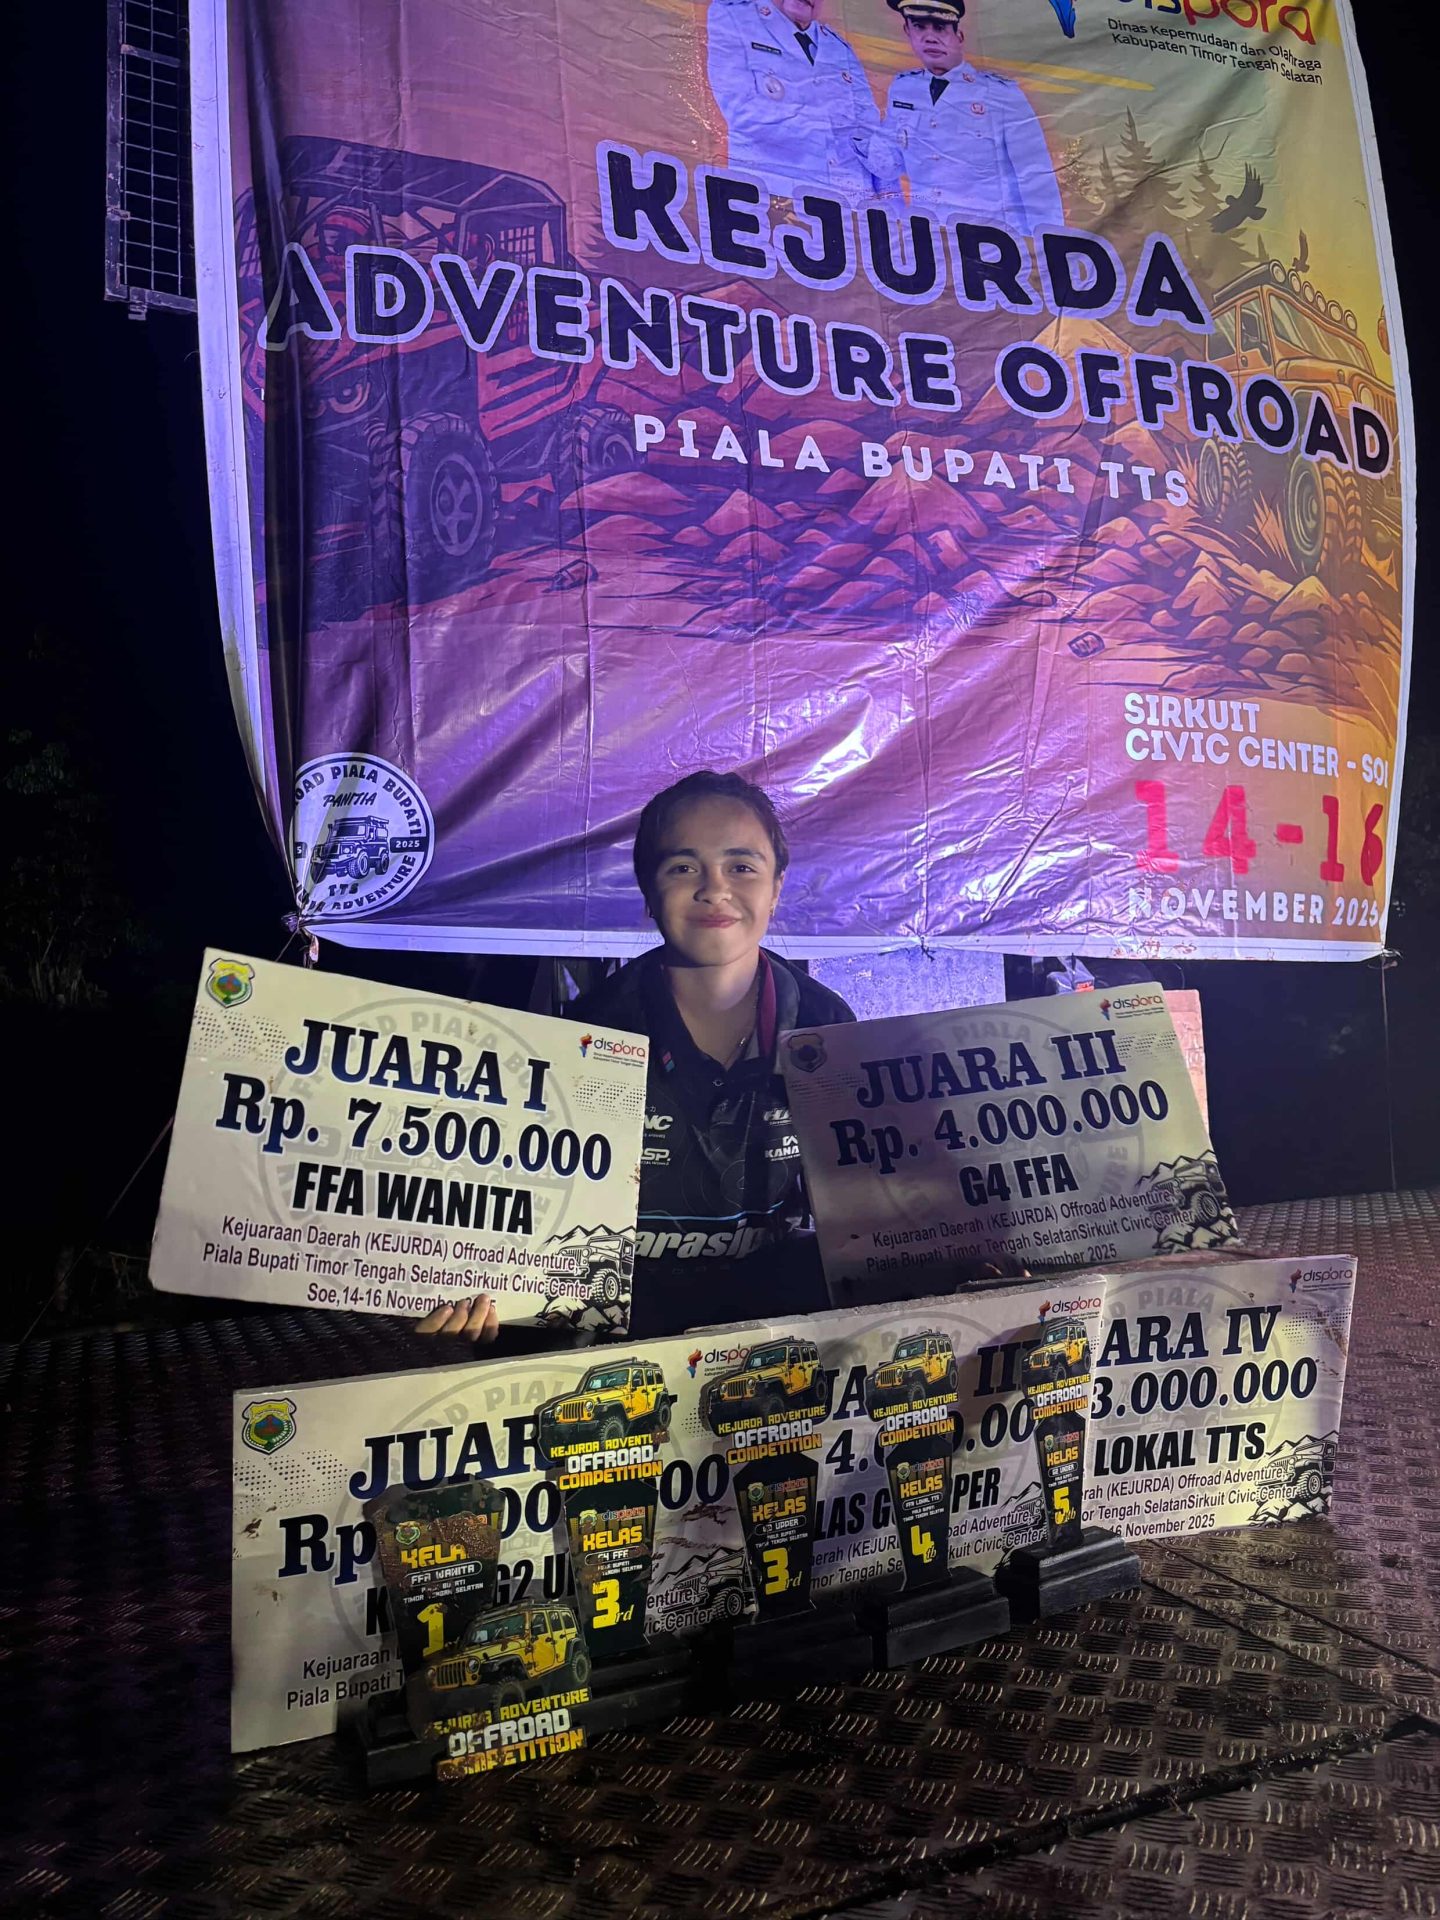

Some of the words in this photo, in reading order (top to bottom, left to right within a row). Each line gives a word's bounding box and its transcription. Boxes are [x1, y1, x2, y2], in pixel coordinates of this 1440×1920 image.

[1108, 18, 1147, 34] Dinas
[1150, 24, 1238, 52] Kepemudaan
[1240, 40, 1265, 57] dan
[1268, 45, 1322, 71] Olahraga
[1111, 33, 1187, 56] Kabupaten
[1189, 45, 1227, 66] Timor
[1230, 55, 1279, 73] Tengah
[1281, 63, 1323, 86] Selatan
[600, 144, 1210, 330] KEJURDA
[260, 244, 960, 410] ADVENTURE
[997, 343, 1391, 477] OFFROAD
[634, 415, 831, 473] PIALA
[862, 441, 1075, 495] BUPATI
[1099, 463, 1190, 507] TTS
[1123, 692, 1260, 733] SIRKUIT
[1125, 728, 1229, 764] CIVIC
[1238, 736, 1339, 778] CENTER
[322, 792, 378, 808] PANITIA
[330, 764, 378, 784] PIALA
[382, 778, 422, 835] BUPATI
[395, 840, 421, 849] 2025
[328, 883, 359, 897] TTS
[331, 855, 416, 911] ADVENTURE
[1128, 888, 1323, 924] NOVEMBER
[1331, 898, 1379, 927] 2025
[1113, 994, 1163, 1010] dispora
[594, 1038, 645, 1057] dispora
[285, 1019, 508, 1105] JUARA
[523, 1058, 551, 1112] I
[857, 1042, 1047, 1108] JUARA
[1051, 1030, 1126, 1081] III
[215, 1073, 319, 1154] Rp.
[348, 1097, 612, 1181] 7.500.000
[830, 1119, 918, 1174] Rp.
[935, 1081, 1169, 1150] 4.000.000
[959, 1163, 1012, 1206] G4
[1014, 1154, 1079, 1198] FFA
[292, 1161, 364, 1216] FFA
[377, 1172, 533, 1235] WANITA
[872, 1226, 937, 1248] Kejuaraan
[940, 1219, 984, 1238] Daerah
[987, 1208, 1058, 1237] (KEJURDA)
[1061, 1200, 1106, 1221] Offroad
[222, 1216, 302, 1242] Kejuaraan
[307, 1226, 361, 1249] Daerah
[365, 1231, 448, 1263] (KEJURDA)
[453, 1241, 503, 1264] Offroad
[866, 1257, 896, 1273] Piala
[901, 1250, 942, 1268] Bupati
[945, 1244, 982, 1261] Timor
[986, 1237, 1030, 1257] Tengah
[1033, 1222, 1121, 1250] SelatanSirkuit
[1121, 1216, 1150, 1232] Civic
[1153, 1210, 1194, 1228] Center
[1088, 1244, 1117, 1261] 2025
[203, 1243, 242, 1265] Piala
[248, 1248, 300, 1273] Bupati
[305, 1253, 348, 1276] Timor
[353, 1259, 406, 1284] Tengah
[411, 1264, 509, 1291] SelatanSirkuit
[512, 1275, 545, 1295] Civic
[549, 1278, 593, 1300] Center
[1303, 1266, 1353, 1283] dispora
[1052, 1296, 1101, 1313] dispora
[1222, 1305, 1282, 1355] IV
[1037, 1385, 1083, 1407] OFFROAD
[1056, 1373, 1091, 1388] ADVENTURE
[1091, 1356, 1318, 1419] 3.000.000
[718, 1417, 762, 1434] KEJURDA
[768, 1406, 826, 1423] ADVENTURE
[873, 1403, 908, 1419] KEJURDA
[912, 1393, 958, 1411] ADVENTURE
[887, 1405, 948, 1431] OFFROAD
[1032, 1395, 1088, 1420] COMPETITION
[734, 1418, 813, 1448] OFFROAD
[880, 1418, 955, 1446] COMPETITION
[550, 1440, 599, 1458] KEJURDA
[567, 1445, 655, 1474] OFFROAD
[727, 1434, 822, 1465] COMPETITION
[1047, 1446, 1079, 1467] KELAS
[1093, 1430, 1196, 1477] LOKAL
[1205, 1422, 1266, 1464] TTS
[559, 1461, 663, 1490] COMPETITION
[900, 1474, 943, 1498] KELAS
[1107, 1476, 1174, 1501] (KEJURDA)
[1178, 1471, 1221, 1489] Offroad
[752, 1496, 807, 1522] KELAS
[1099, 1503, 1140, 1523] Tengah
[1144, 1493, 1225, 1516] SelatanSirkuit
[1228, 1489, 1256, 1504] Civic
[1259, 1484, 1297, 1502] Center
[583, 1525, 643, 1551] KELAS
[1125, 1519, 1186, 1538] November
[1188, 1514, 1216, 1529] 2025
[839, 1560, 883, 1583] Tengah
[974, 1537, 1002, 1557] Civic
[1005, 1528, 1044, 1547] Center
[665, 1608, 712, 1631] Center
[303, 1651, 390, 1679] Kejuaraan
[287, 1687, 329, 1710] Piala
[336, 1672, 391, 1699] Bupati
[500, 1688, 590, 1720] ADVENTURE
[448, 1708, 571, 1758] OFFROAD
